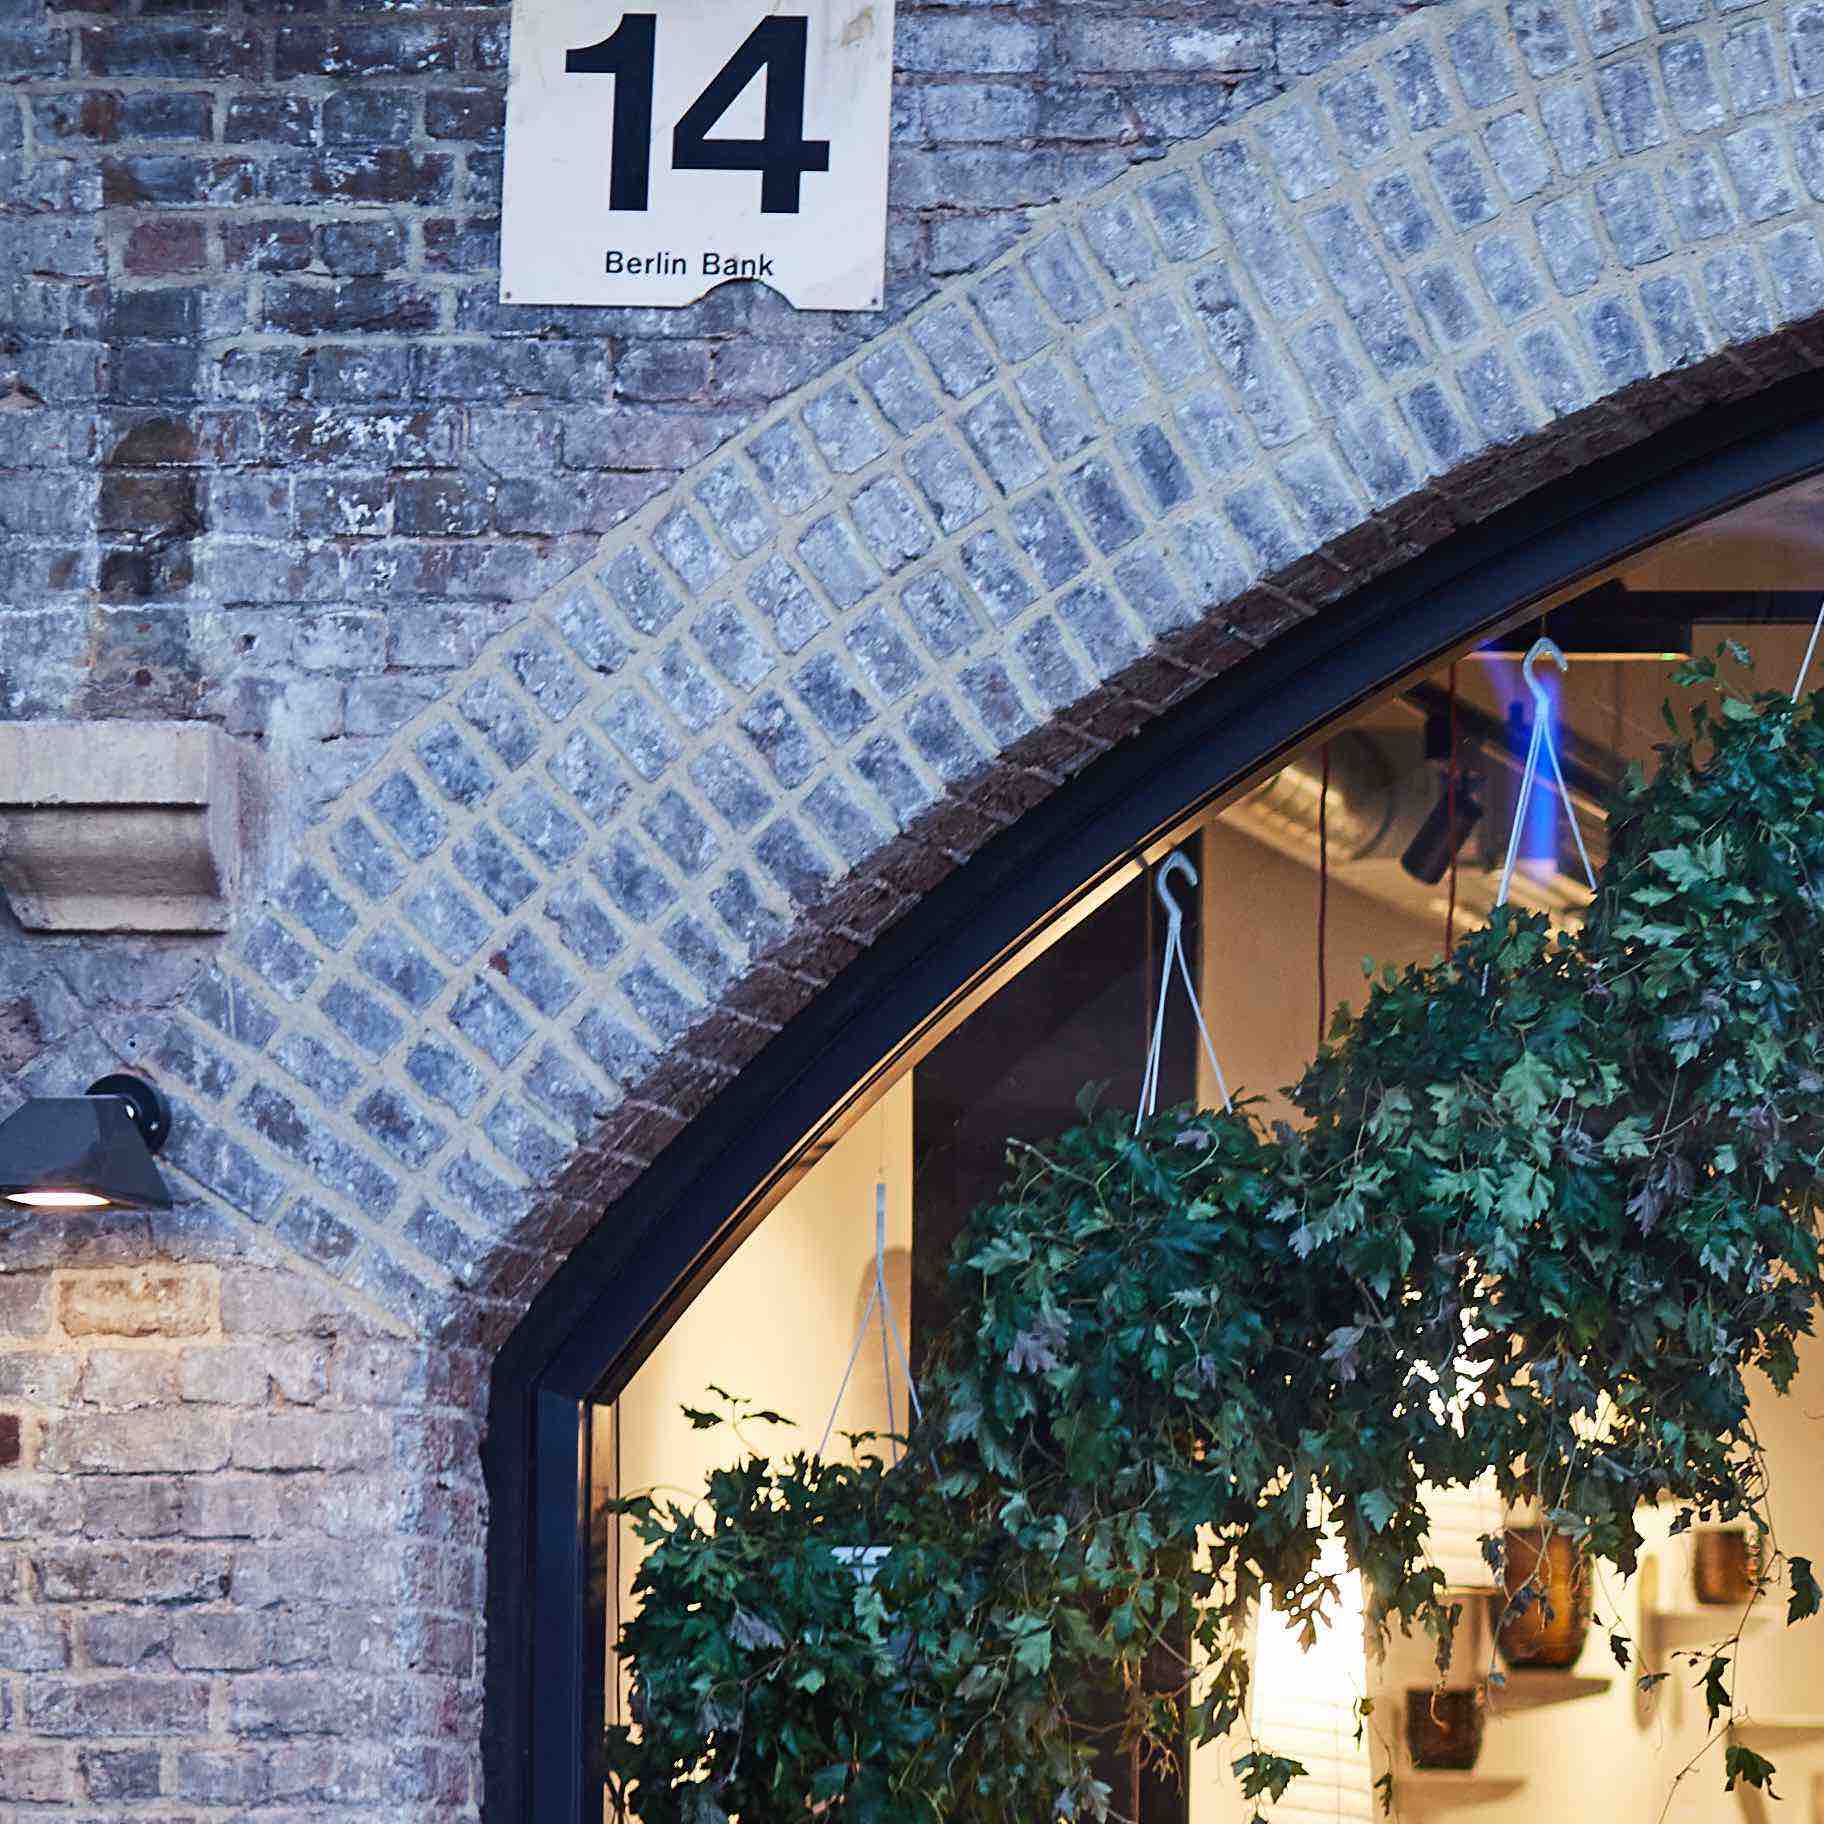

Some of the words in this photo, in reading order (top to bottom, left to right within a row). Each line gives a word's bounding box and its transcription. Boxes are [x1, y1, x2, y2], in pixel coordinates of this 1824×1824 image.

[565, 13, 830, 214] 14
[605, 251, 687, 275] Berlin
[702, 252, 775, 277] Bank
